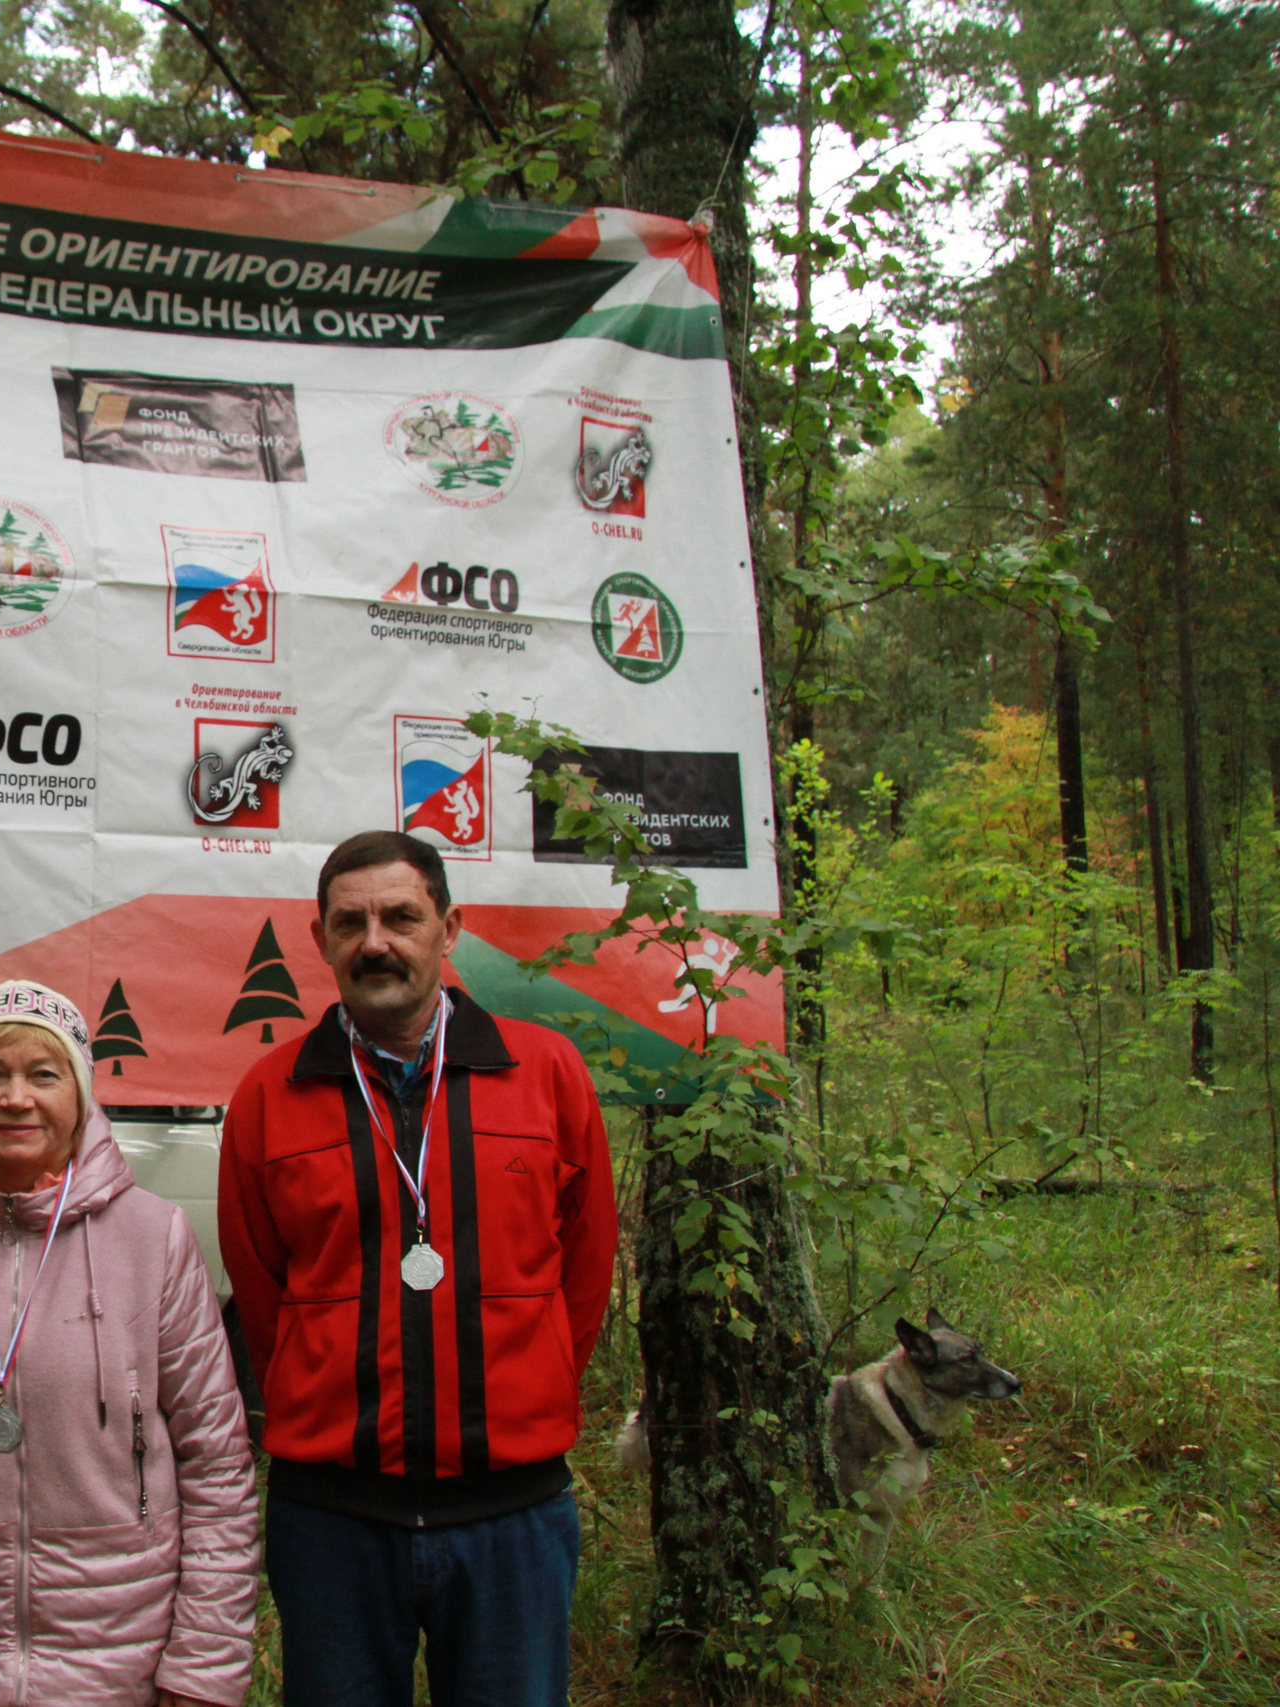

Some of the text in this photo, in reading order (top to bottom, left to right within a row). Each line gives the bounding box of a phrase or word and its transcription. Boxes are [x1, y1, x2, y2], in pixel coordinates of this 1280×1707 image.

[21, 227, 441, 301] ОРИЕНТИРОВАНИЕ
[313, 309, 445, 341] ОКРУГ
[138, 407, 191, 424] ФОНД
[141, 422, 285, 448] ПРЕЗИДЕНТСКИХ
[142, 440, 220, 459] ГРАНТОВ
[421, 561, 519, 613] ФСО
[5, 615, 50, 637] ОБЛАСТИ
[367, 603, 533, 636] Федерация спортивного
[371, 624, 525, 654] ориентирования Югры
[192, 683, 282, 700] Ориентирование
[184, 697, 250, 713] Челябинской
[253, 701, 298, 715] области
[39, 789, 87, 810] Югры
[602, 792, 645, 808] ФОНД
[202, 836, 271, 854] O-CHEL.RU
